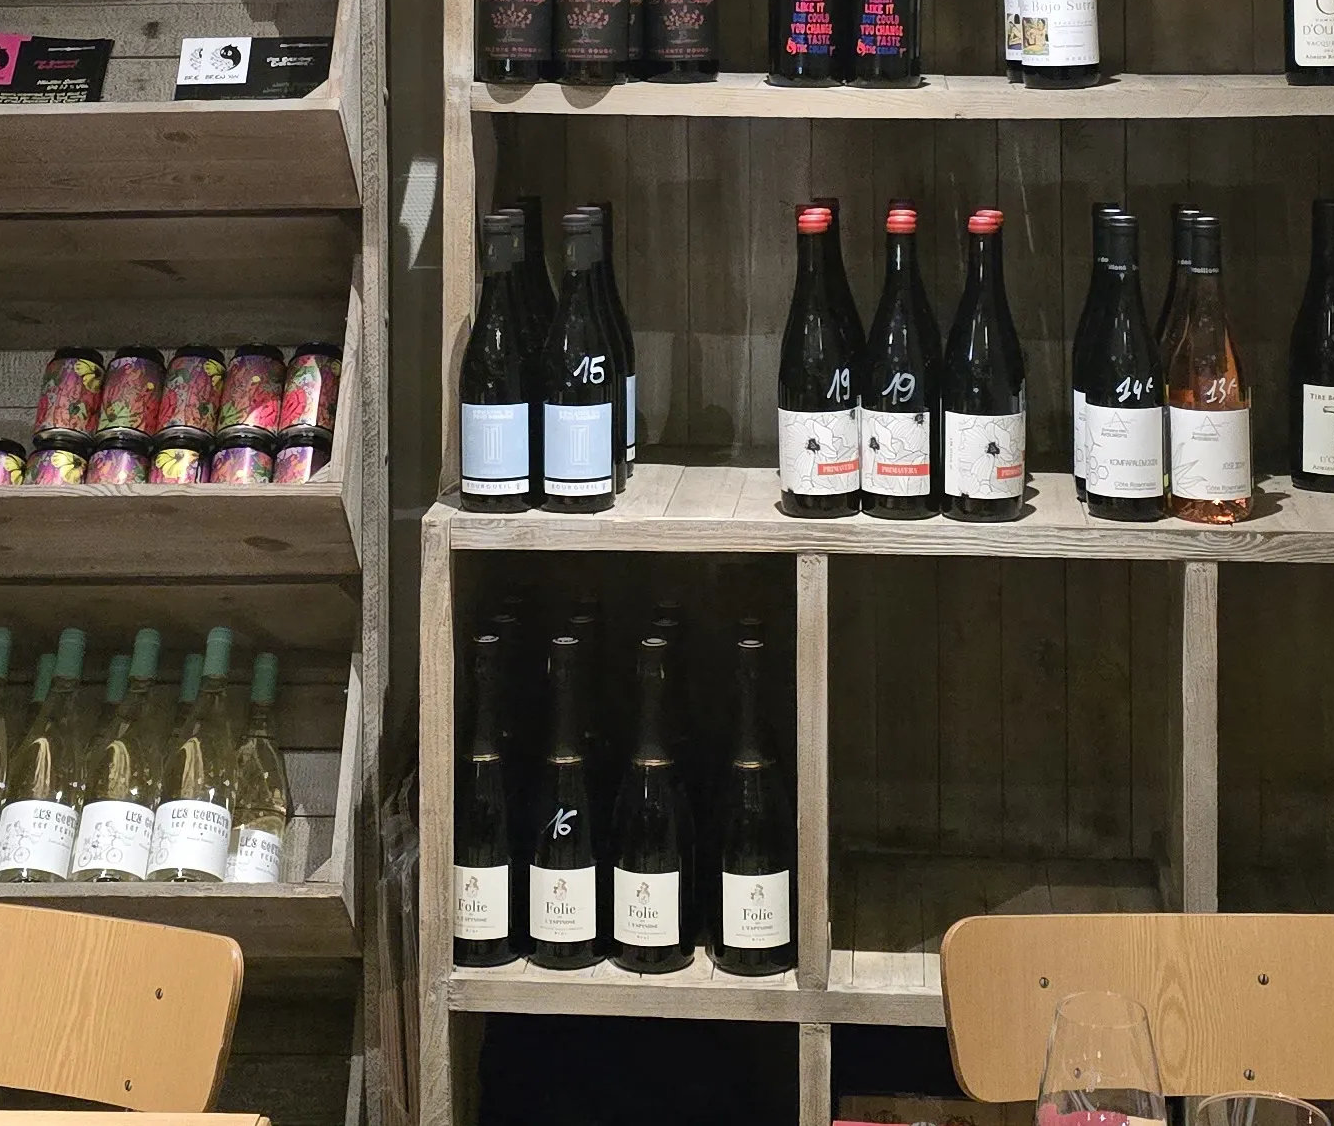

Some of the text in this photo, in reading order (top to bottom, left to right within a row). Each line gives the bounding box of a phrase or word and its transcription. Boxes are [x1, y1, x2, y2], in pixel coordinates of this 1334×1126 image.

[796, 3, 825, 13] LIKE IT
[865, 4, 894, 14] LIKE IT
[1032, 1, 1060, 14] Bojo
[808, 14, 829, 23] COULD
[876, 15, 899, 25] COULD
[791, 24, 832, 34] YOU CHANGE
[860, 25, 903, 36] YOU CHANGE
[807, 35, 830, 44] TASTE
[877, 36, 900, 46] TASTE
[573, 356, 605, 384] 15
[827, 367, 851, 403] 19
[882, 372, 916, 405] 19
[541, 808, 577, 839] 16
[457, 899, 487, 913] Folie
[546, 901, 576, 916] Folie
[628, 905, 659, 919] Folie
[742, 908, 773, 922] Folie
